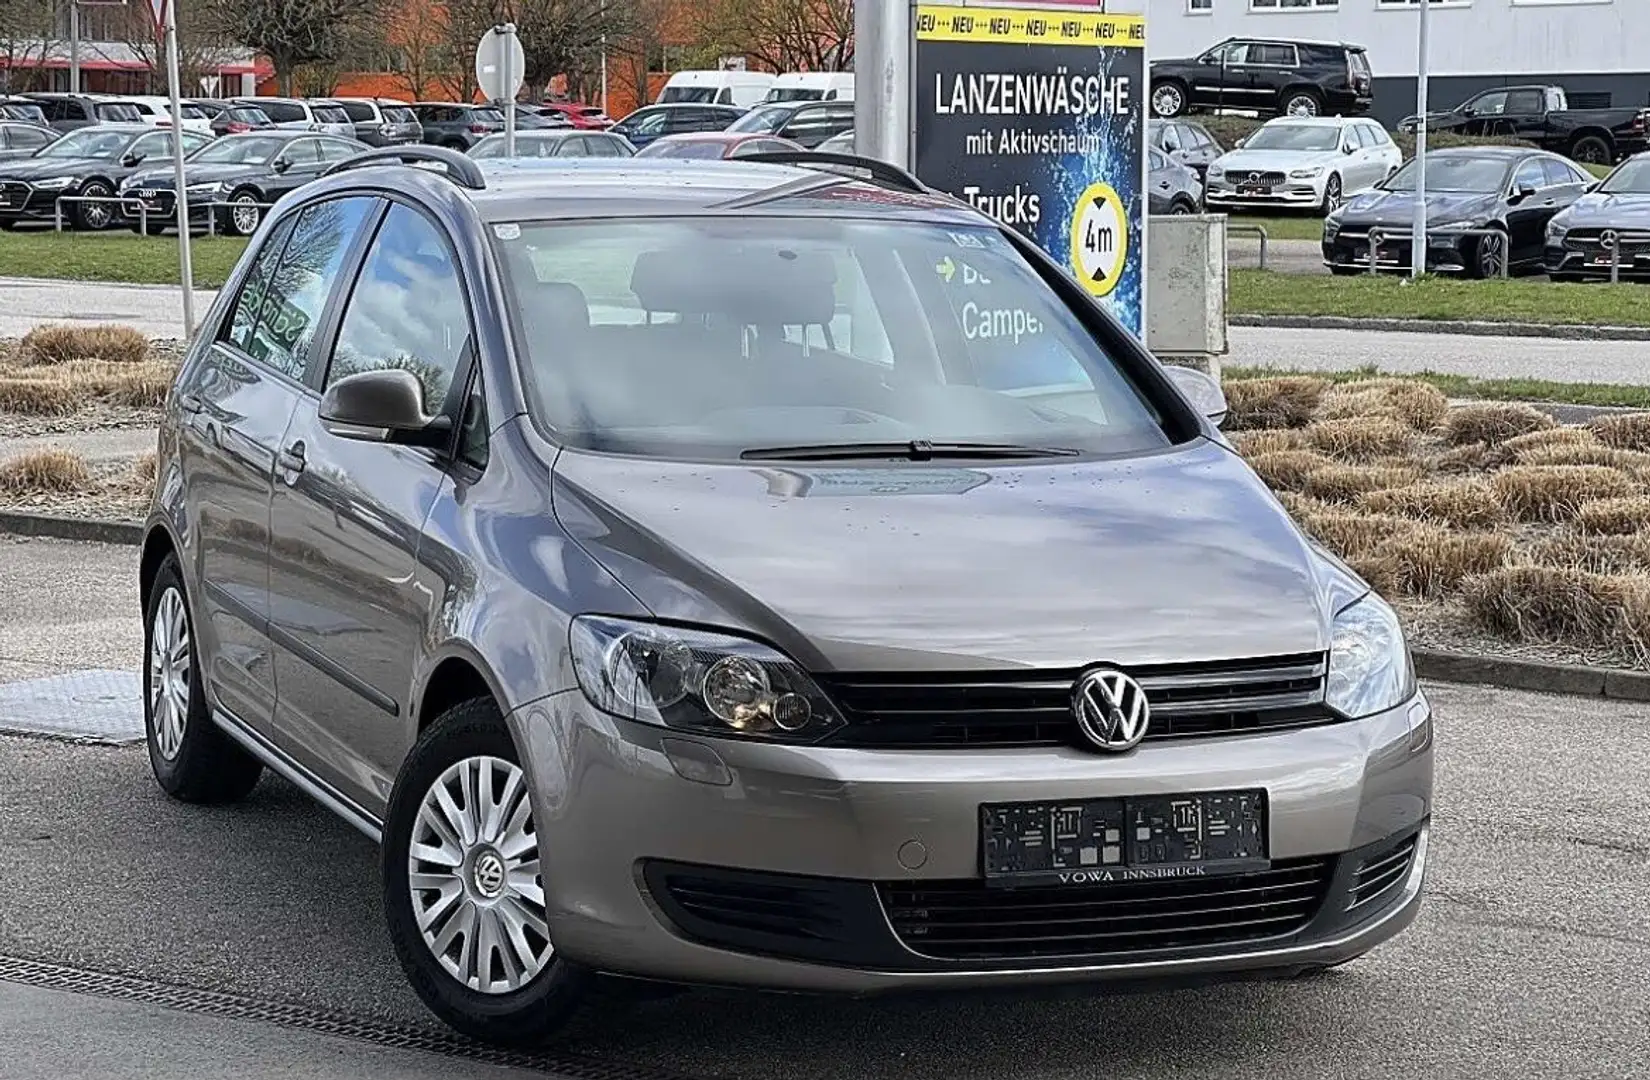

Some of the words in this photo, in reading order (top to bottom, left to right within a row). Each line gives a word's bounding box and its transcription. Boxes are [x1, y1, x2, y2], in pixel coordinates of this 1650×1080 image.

[952, 16, 974, 33] NEU
[989, 18, 1011, 34] NEU
[1026, 19, 1047, 36] NEU
[1061, 21, 1081, 37] NEU
[1095, 22, 1116, 38] NEU
[935, 66, 1130, 115] LANZENWÄSCHE
[966, 130, 993, 155] mit
[999, 128, 1101, 155] Aktivschaum
[964, 185, 1040, 224] Trucks
[1058, 871, 1114, 884] VOWA
[1123, 865, 1206, 880] INNSBRUCK
